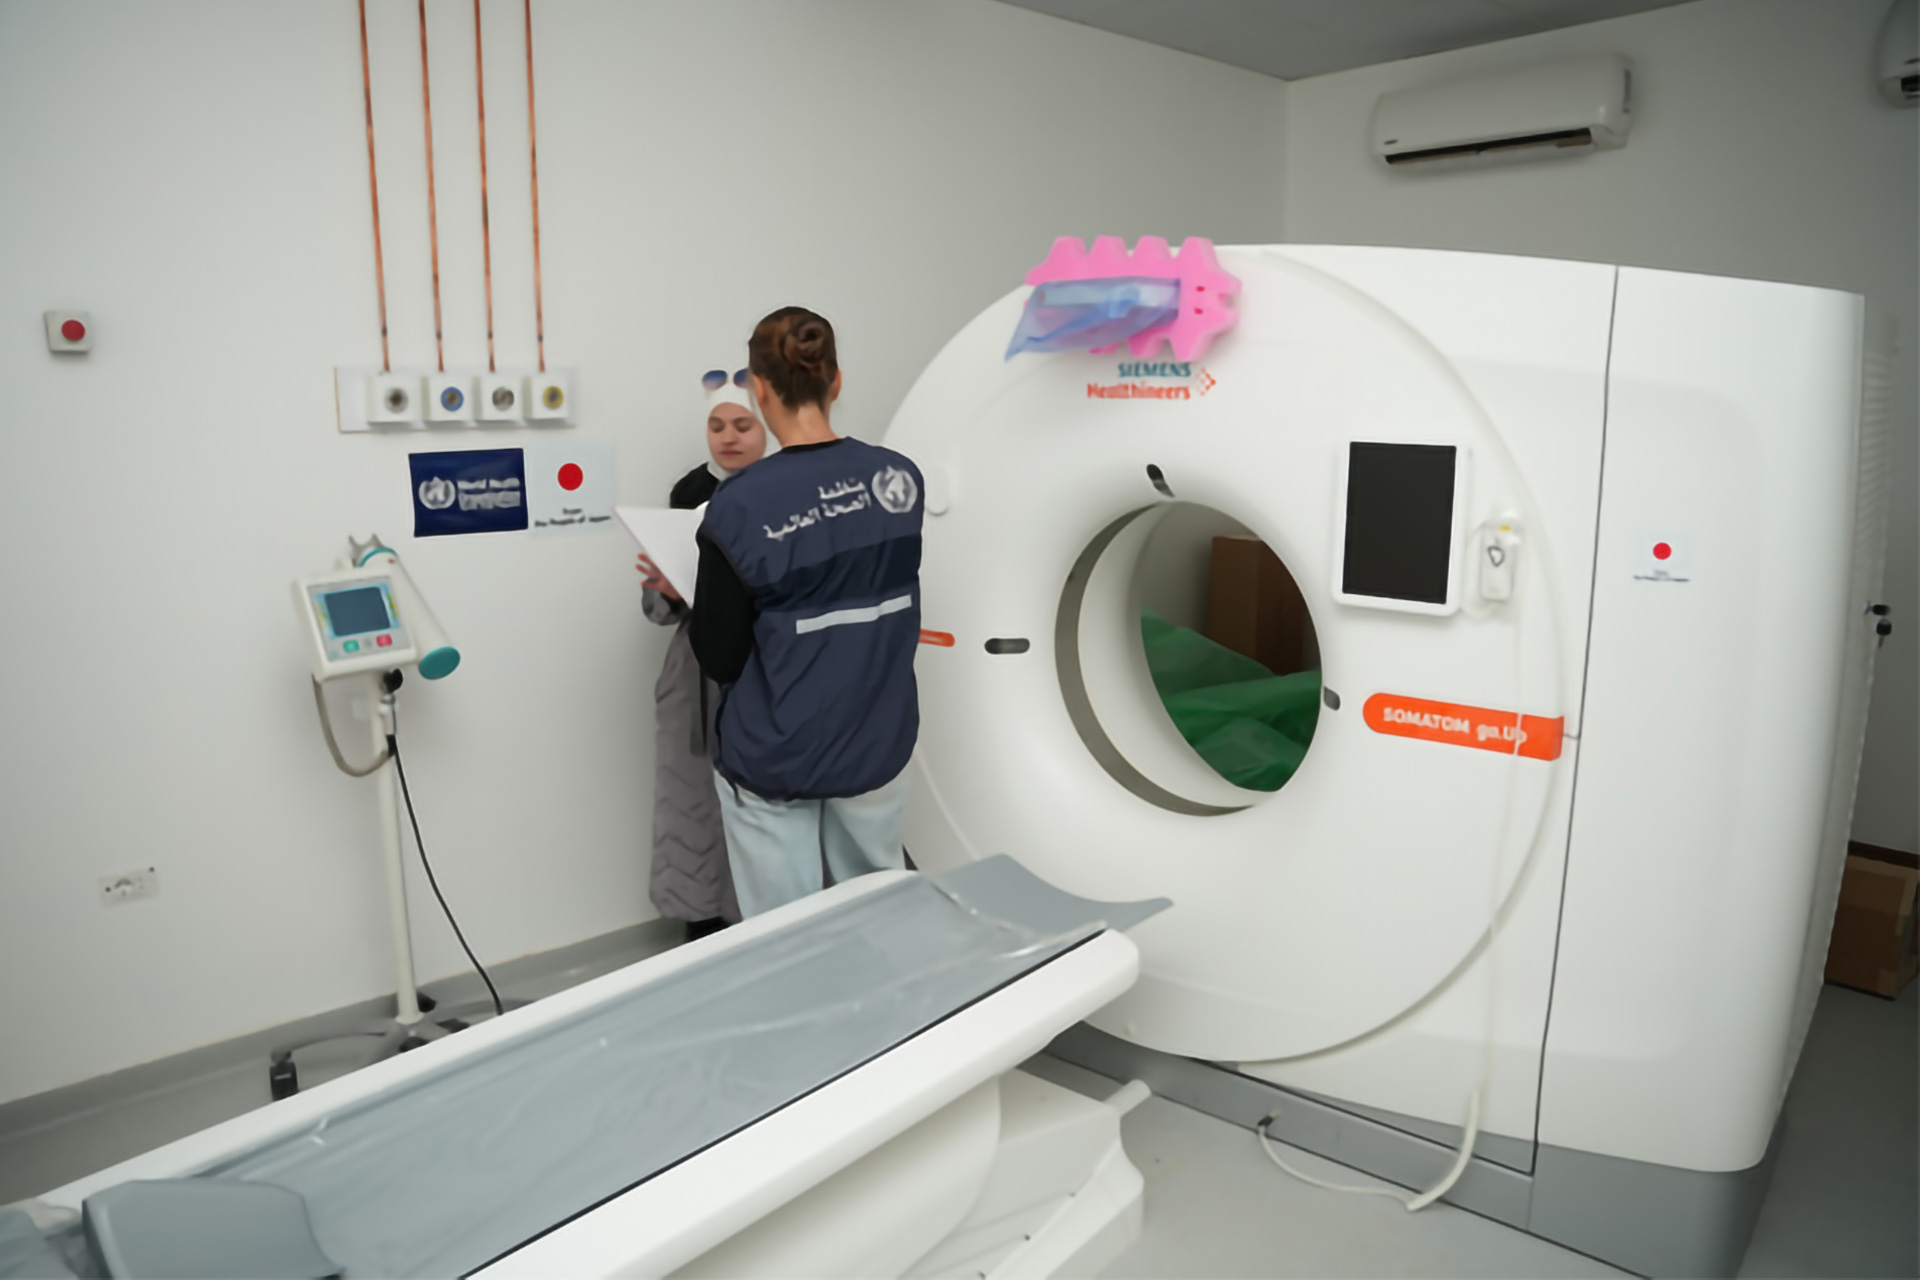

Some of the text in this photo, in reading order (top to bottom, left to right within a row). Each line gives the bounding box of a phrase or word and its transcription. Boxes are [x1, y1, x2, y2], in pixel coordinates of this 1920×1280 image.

[1117, 361, 1191, 377] SIEMENS
[1087, 381, 1190, 400] Healthineers
[817, 477, 866, 500] منظمة
[763, 491, 871, 542] الصحة العالمية
[1383, 706, 1471, 734] SOMATOM
